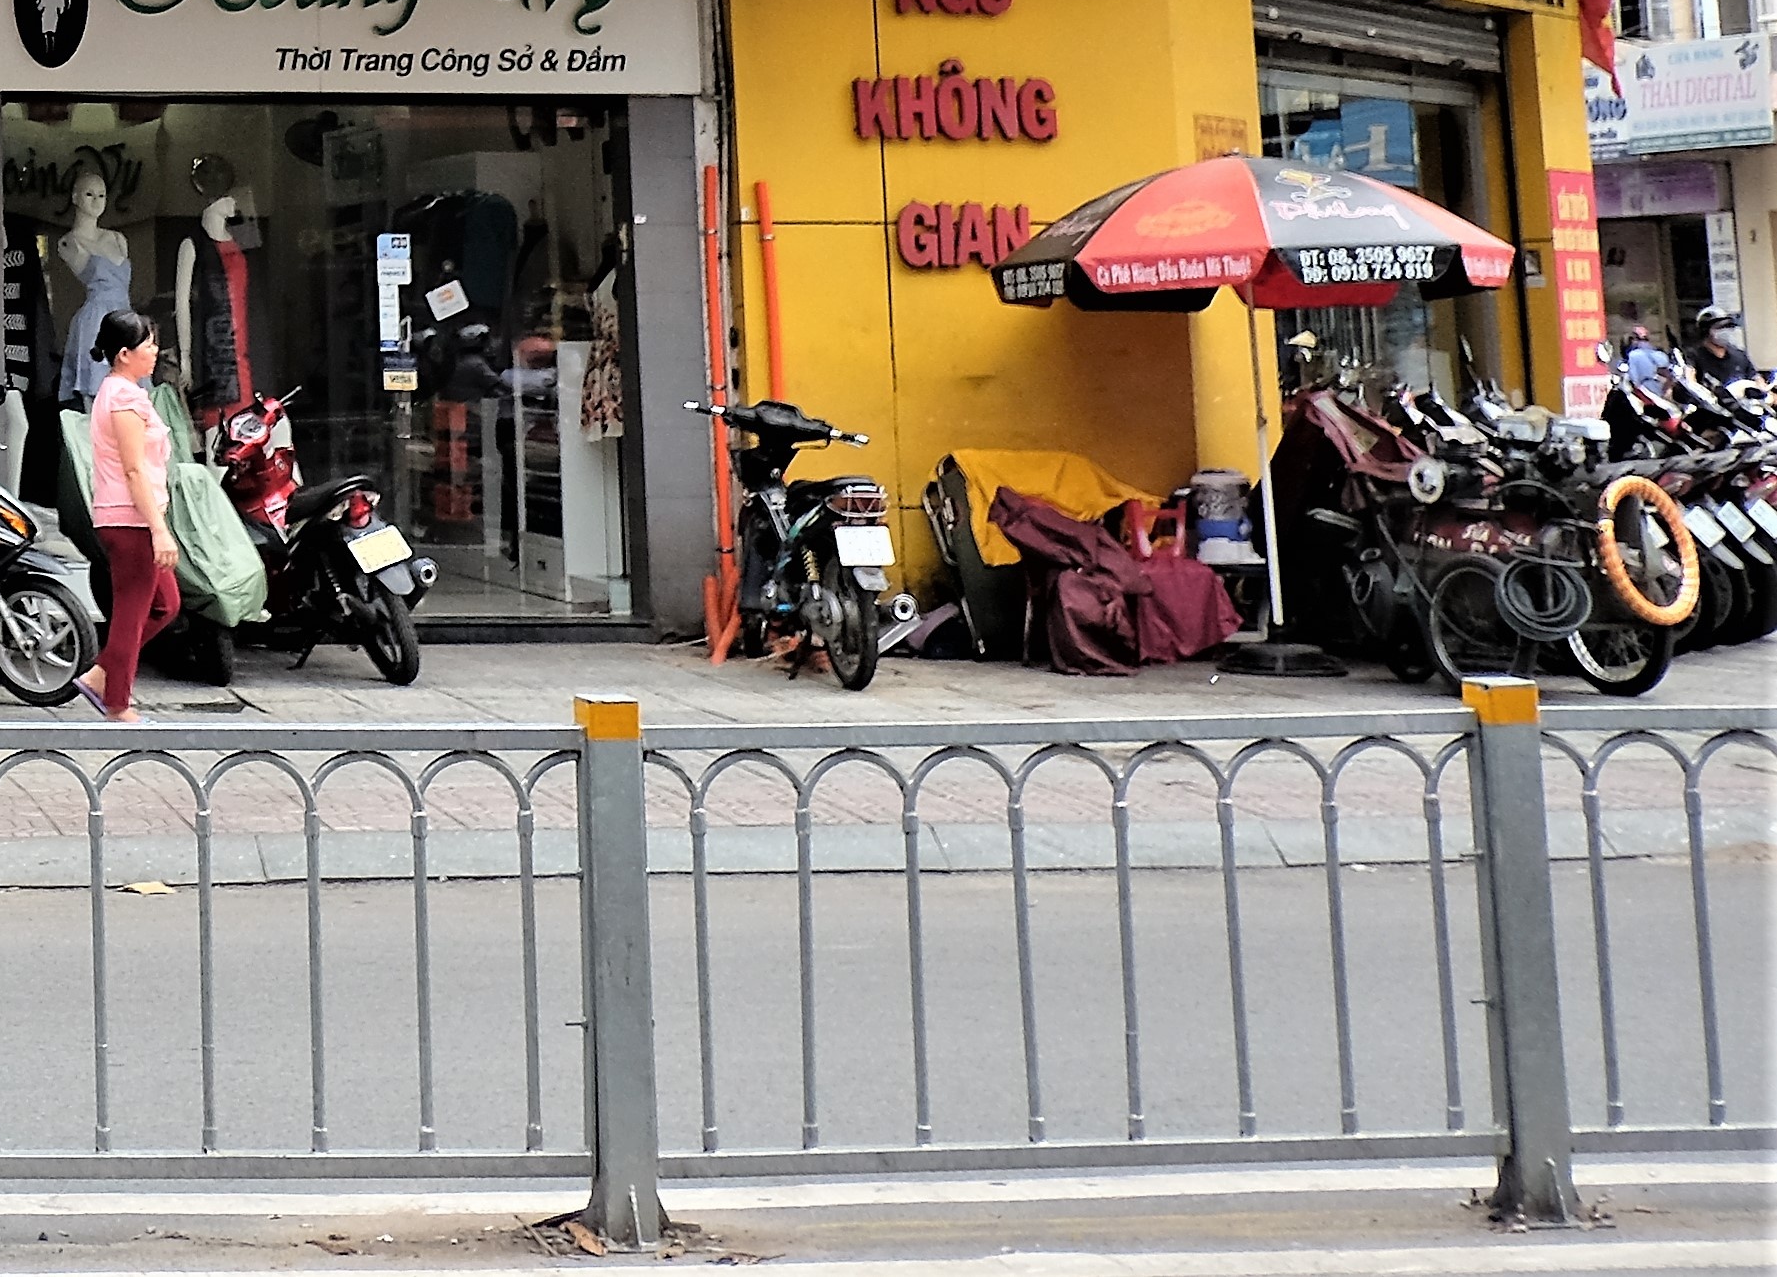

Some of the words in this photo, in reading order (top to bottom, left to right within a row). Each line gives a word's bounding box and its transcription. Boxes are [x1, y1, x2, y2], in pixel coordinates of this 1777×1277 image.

[275, 47, 332, 74] Thời
[340, 47, 414, 79] Trang
[421, 46, 491, 79] Công
[498, 45, 533, 74] Sở
[540, 49, 560, 73] &
[851, 58, 1059, 144] KHÔNG
[896, 200, 1030, 269] GIAN
